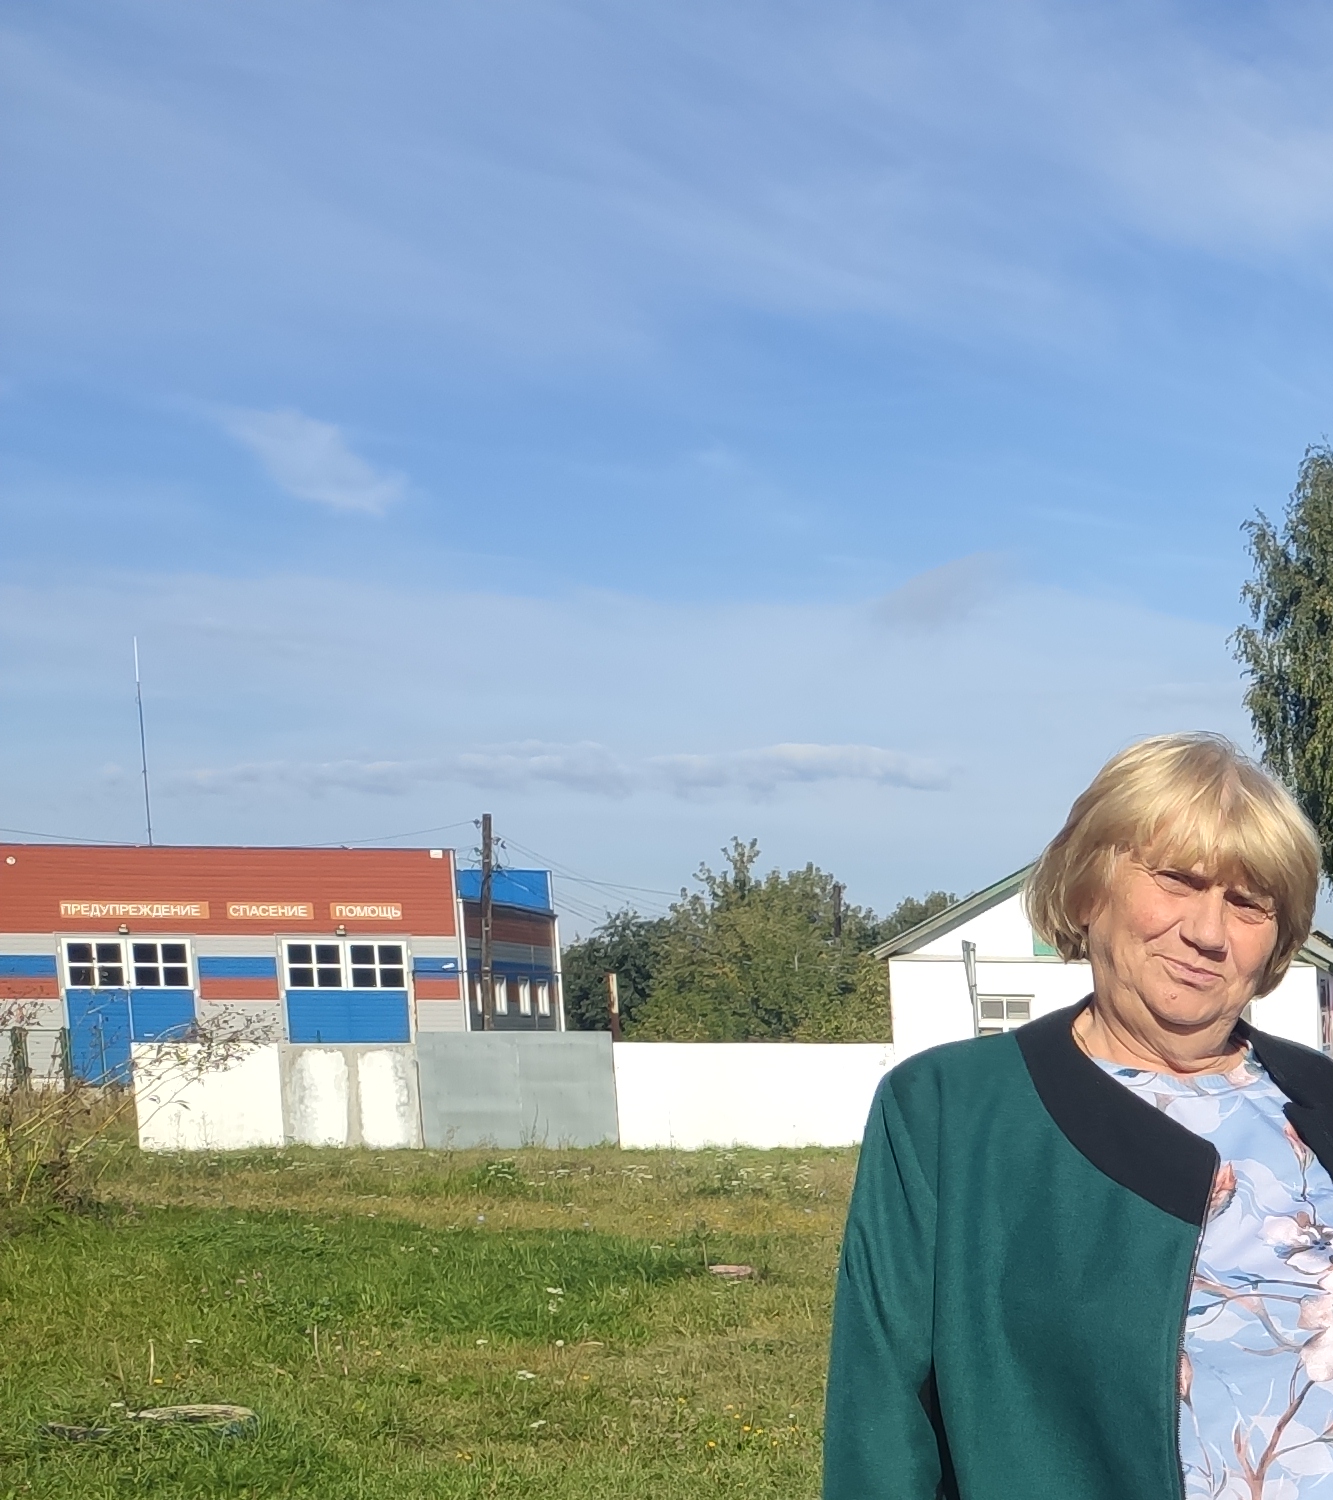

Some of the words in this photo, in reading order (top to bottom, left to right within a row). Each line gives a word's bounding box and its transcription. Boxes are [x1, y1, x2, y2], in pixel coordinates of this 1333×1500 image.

[60, 903, 201, 917] ПРЕДУПРЕЖДЕНИЕ
[229, 905, 308, 917] СПАСЕНИЕ
[335, 906, 401, 919] ПОМОЩЬ
